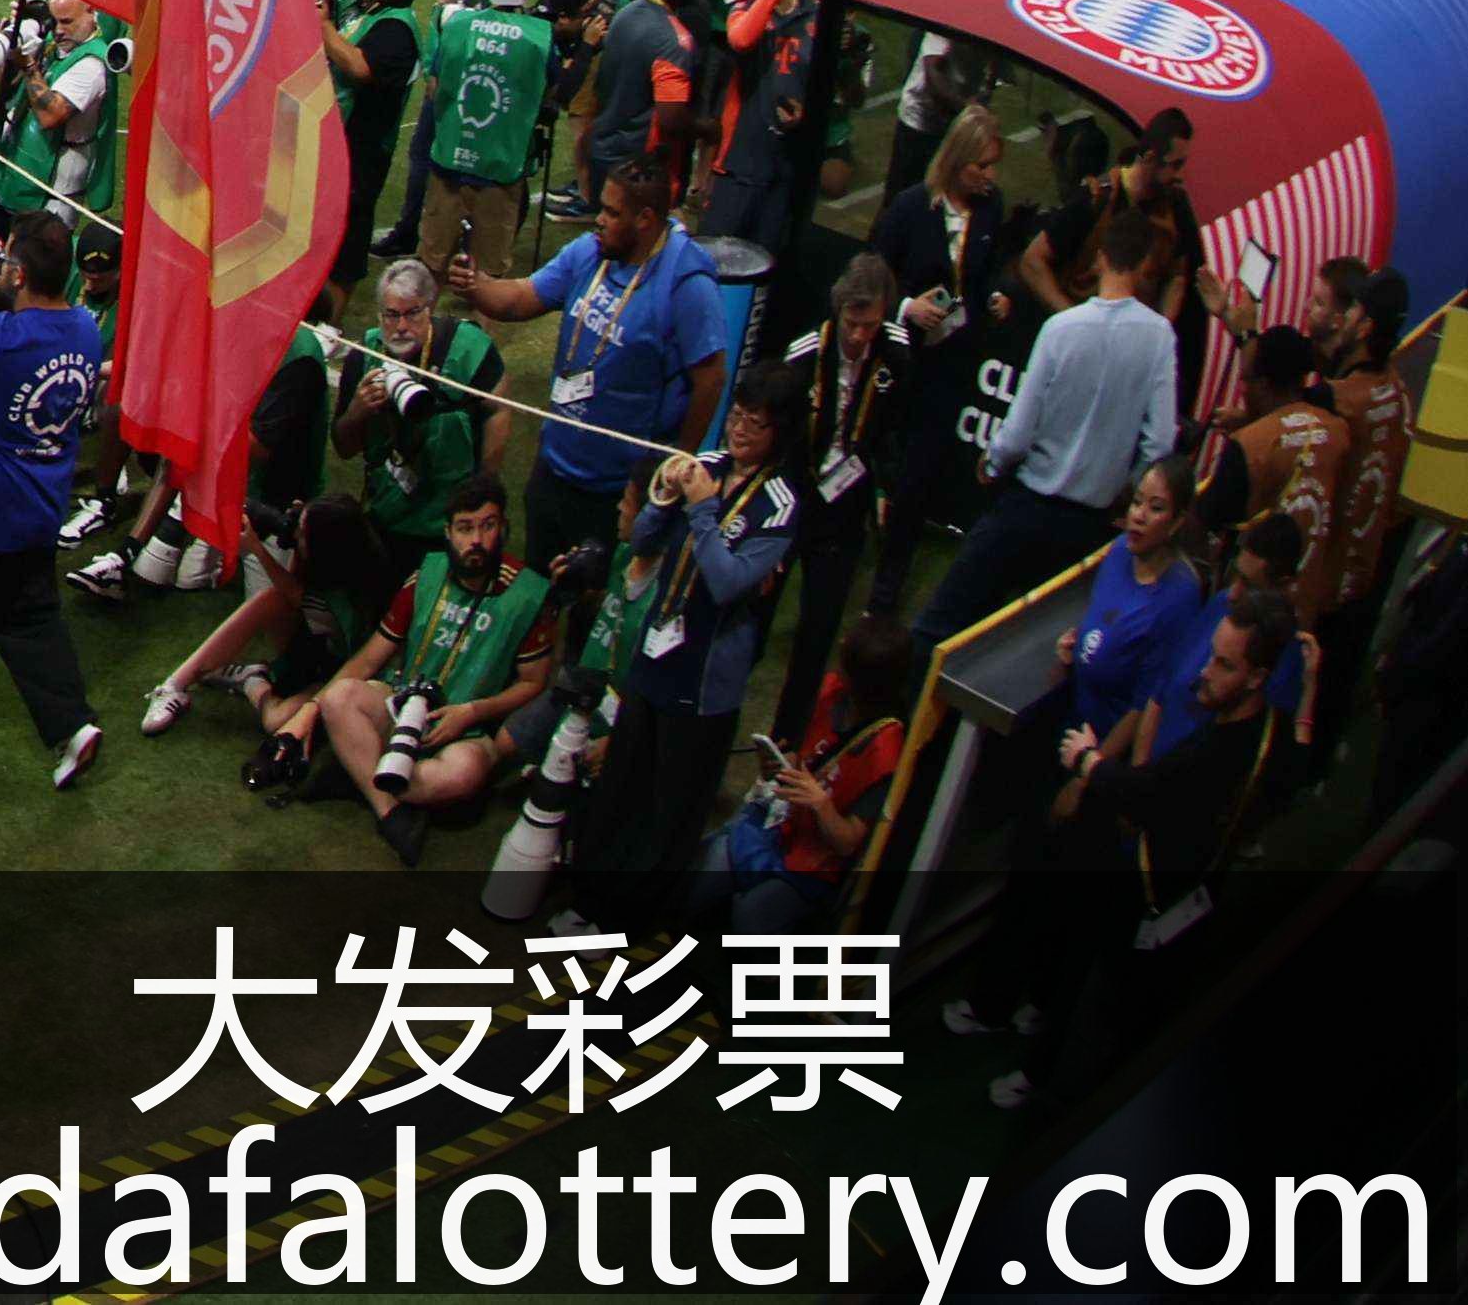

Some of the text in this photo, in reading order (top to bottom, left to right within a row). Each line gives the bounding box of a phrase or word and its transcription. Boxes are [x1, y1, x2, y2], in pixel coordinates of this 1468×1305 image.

[470, 20, 523, 42] PHOTO
[1031, 9, 1084, 35] FC
[8, 382, 32, 422] CLUB
[35, 352, 84, 379] WORLD
